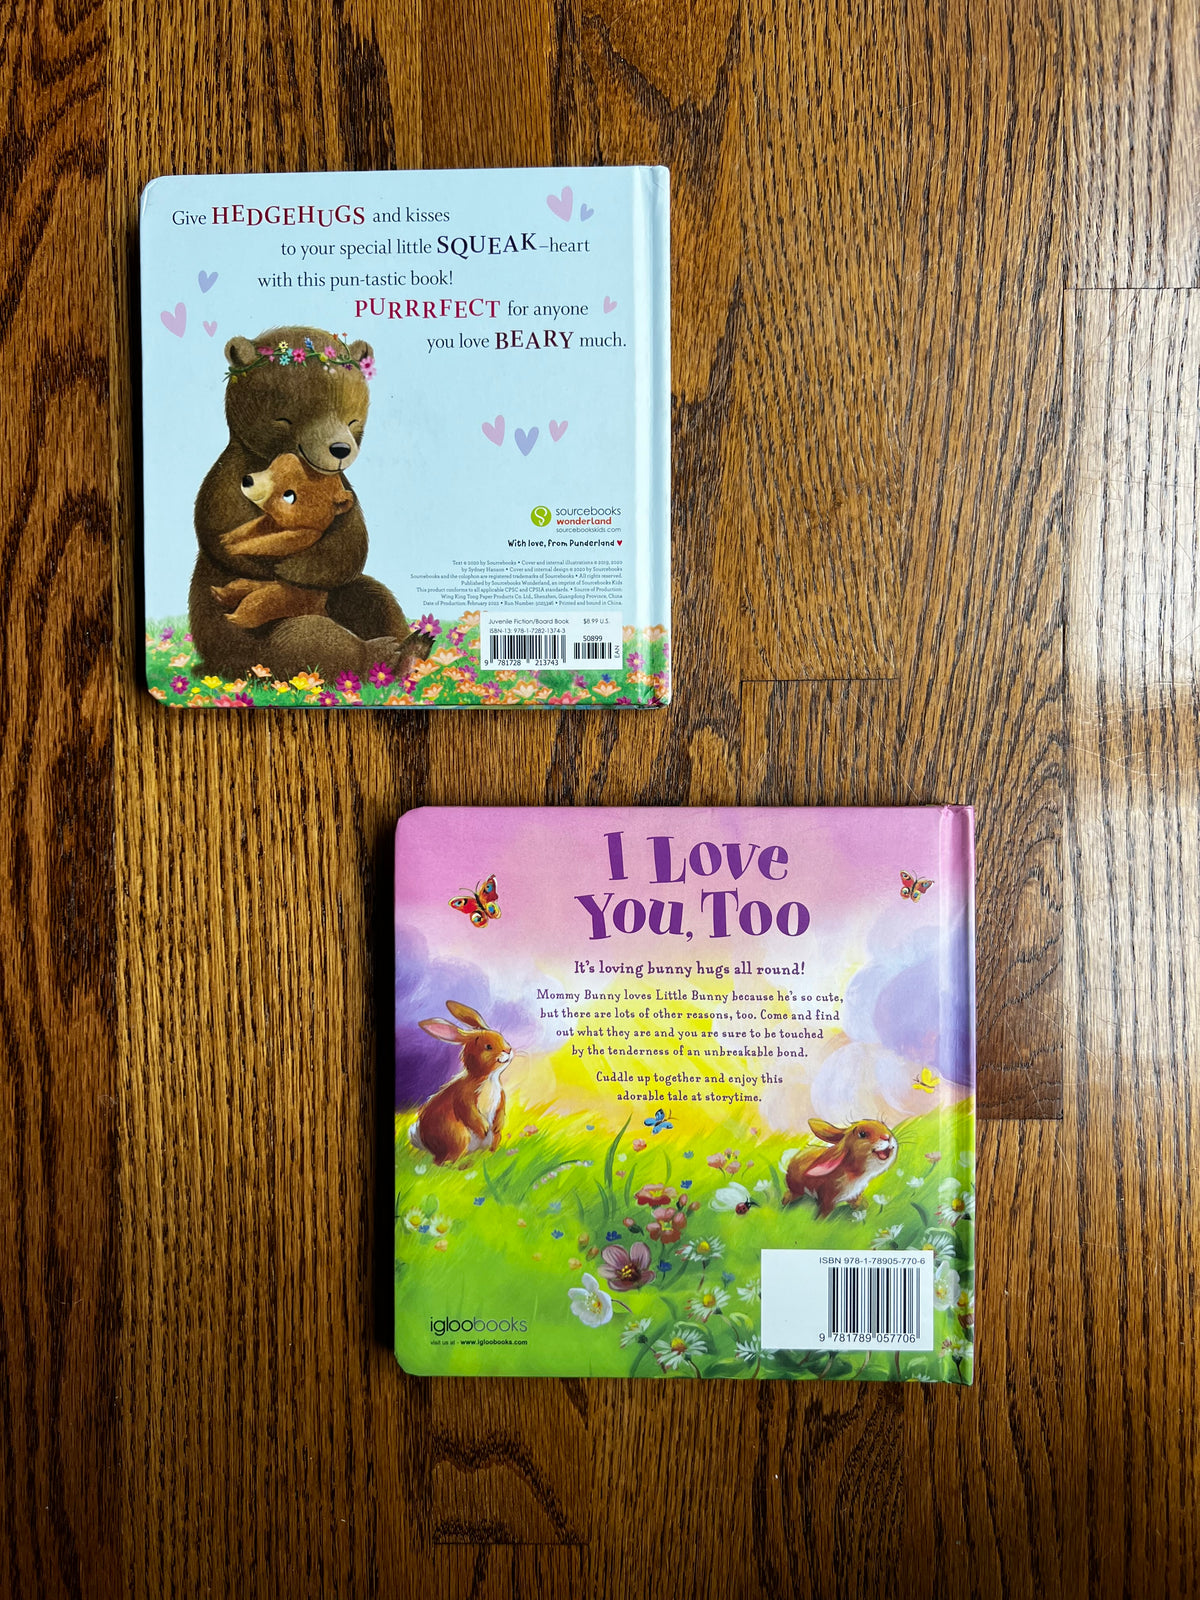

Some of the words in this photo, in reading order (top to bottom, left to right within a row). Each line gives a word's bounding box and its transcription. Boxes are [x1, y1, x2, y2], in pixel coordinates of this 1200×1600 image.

[172, 210, 207, 226] Give
[211, 204, 365, 227] HEDGEHUGS
[372, 207, 401, 222] and
[406, 207, 450, 223] kisses
[281, 242, 296, 256] to
[300, 244, 335, 260] your
[339, 239, 392, 260] special
[397, 239, 432, 254] little
[257, 272, 292, 287] with
[297, 271, 326, 287] this
[330, 271, 406, 291] pun-tastic
[410, 269, 453, 286] book!
[355, 297, 501, 319] PURRRFECT
[508, 300, 529, 316] for
[533, 304, 589, 320] anyone
[427, 336, 454, 353] you
[459, 333, 490, 349] love
[495, 329, 574, 350] BEARY
[579, 331, 627, 347] much.
[555, 506, 622, 516] sourcebooks
[556, 517, 612, 525] wonderland
[507, 539, 527, 547] With
[528, 539, 547, 548] love,
[547, 539, 568, 547] from
[569, 539, 615, 547] Punderland
[603, 831, 629, 881] I
[646, 836, 789, 884] Love
[574, 892, 693, 942] You,
[700, 887, 811, 938] Too
[574, 960, 595, 974] It's
[599, 960, 643, 979] loving
[648, 961, 692, 978] bunny
[696, 961, 730, 979] hugs
[734, 961, 752, 975] all
[756, 961, 805, 976] round!
[537, 989, 580, 1002] Mommy
[584, 989, 621, 1003] Bunny
[624, 989, 652, 1000] loves
[655, 989, 687, 1001] Little
[691, 990, 729, 1003] Bunny
[732, 990, 774, 1002] because
[777, 990, 797, 1002] he's
[800, 993, 813, 1002] so
[815, 992, 844, 1004] cute,
[540, 1007, 559, 1018] but
[561, 1007, 591, 1018] there
[594, 1010, 612, 1019] are
[614, 1007, 635, 1019] lots
[638, 1007, 650, 1019] of
[653, 1008, 683, 1019] other
[686, 1011, 733, 1021] reasons,
[736, 1010, 757, 1020] too.
[760, 1009, 788, 1020] Come
[791, 1010, 812, 1020] and
[815, 1009, 840, 1021] find
[556, 1027, 574, 1037] out
[577, 1025, 603, 1037] what
[606, 1025, 630, 1039] they
[633, 1029, 651, 1037] are
[654, 1027, 674, 1037] and
[678, 1030, 698, 1040] you
[701, 1030, 718, 1038] are
[721, 1030, 747, 1038] sure
[749, 1028, 761, 1038] to
[764, 1028, 776, 1039] be
[780, 1027, 824, 1039] touched
[572, 1044, 584, 1057] by
[587, 1044, 605, 1055] the
[608, 1045, 669, 1056] tenderness
[672, 1045, 684, 1056] of
[687, 1049, 700, 1057] an
[704, 1046, 774, 1057] unbreakable
[777, 1046, 808, 1057] bond.
[596, 1071, 634, 1082] Cuddle
[637, 1074, 651, 1085] up
[653, 1072, 701, 1086] together
[704, 1073, 725, 1083] and
[728, 1073, 758, 1087] enjoy
[761, 1072, 783, 1084] this
[617, 1090, 665, 1101] adorable
[667, 1090, 688, 1101] tale
[691, 1091, 702, 1101] at
[705, 1092, 762, 1105] storytime.
[844, 1257, 926, 1265] 978-1-78905-770-6
[430, 1316, 528, 1336] igloobooks
[819, 1333, 825, 1342] 9
[833, 1333, 872, 1343] 781789
[876, 1334, 916, 1343] 057706
